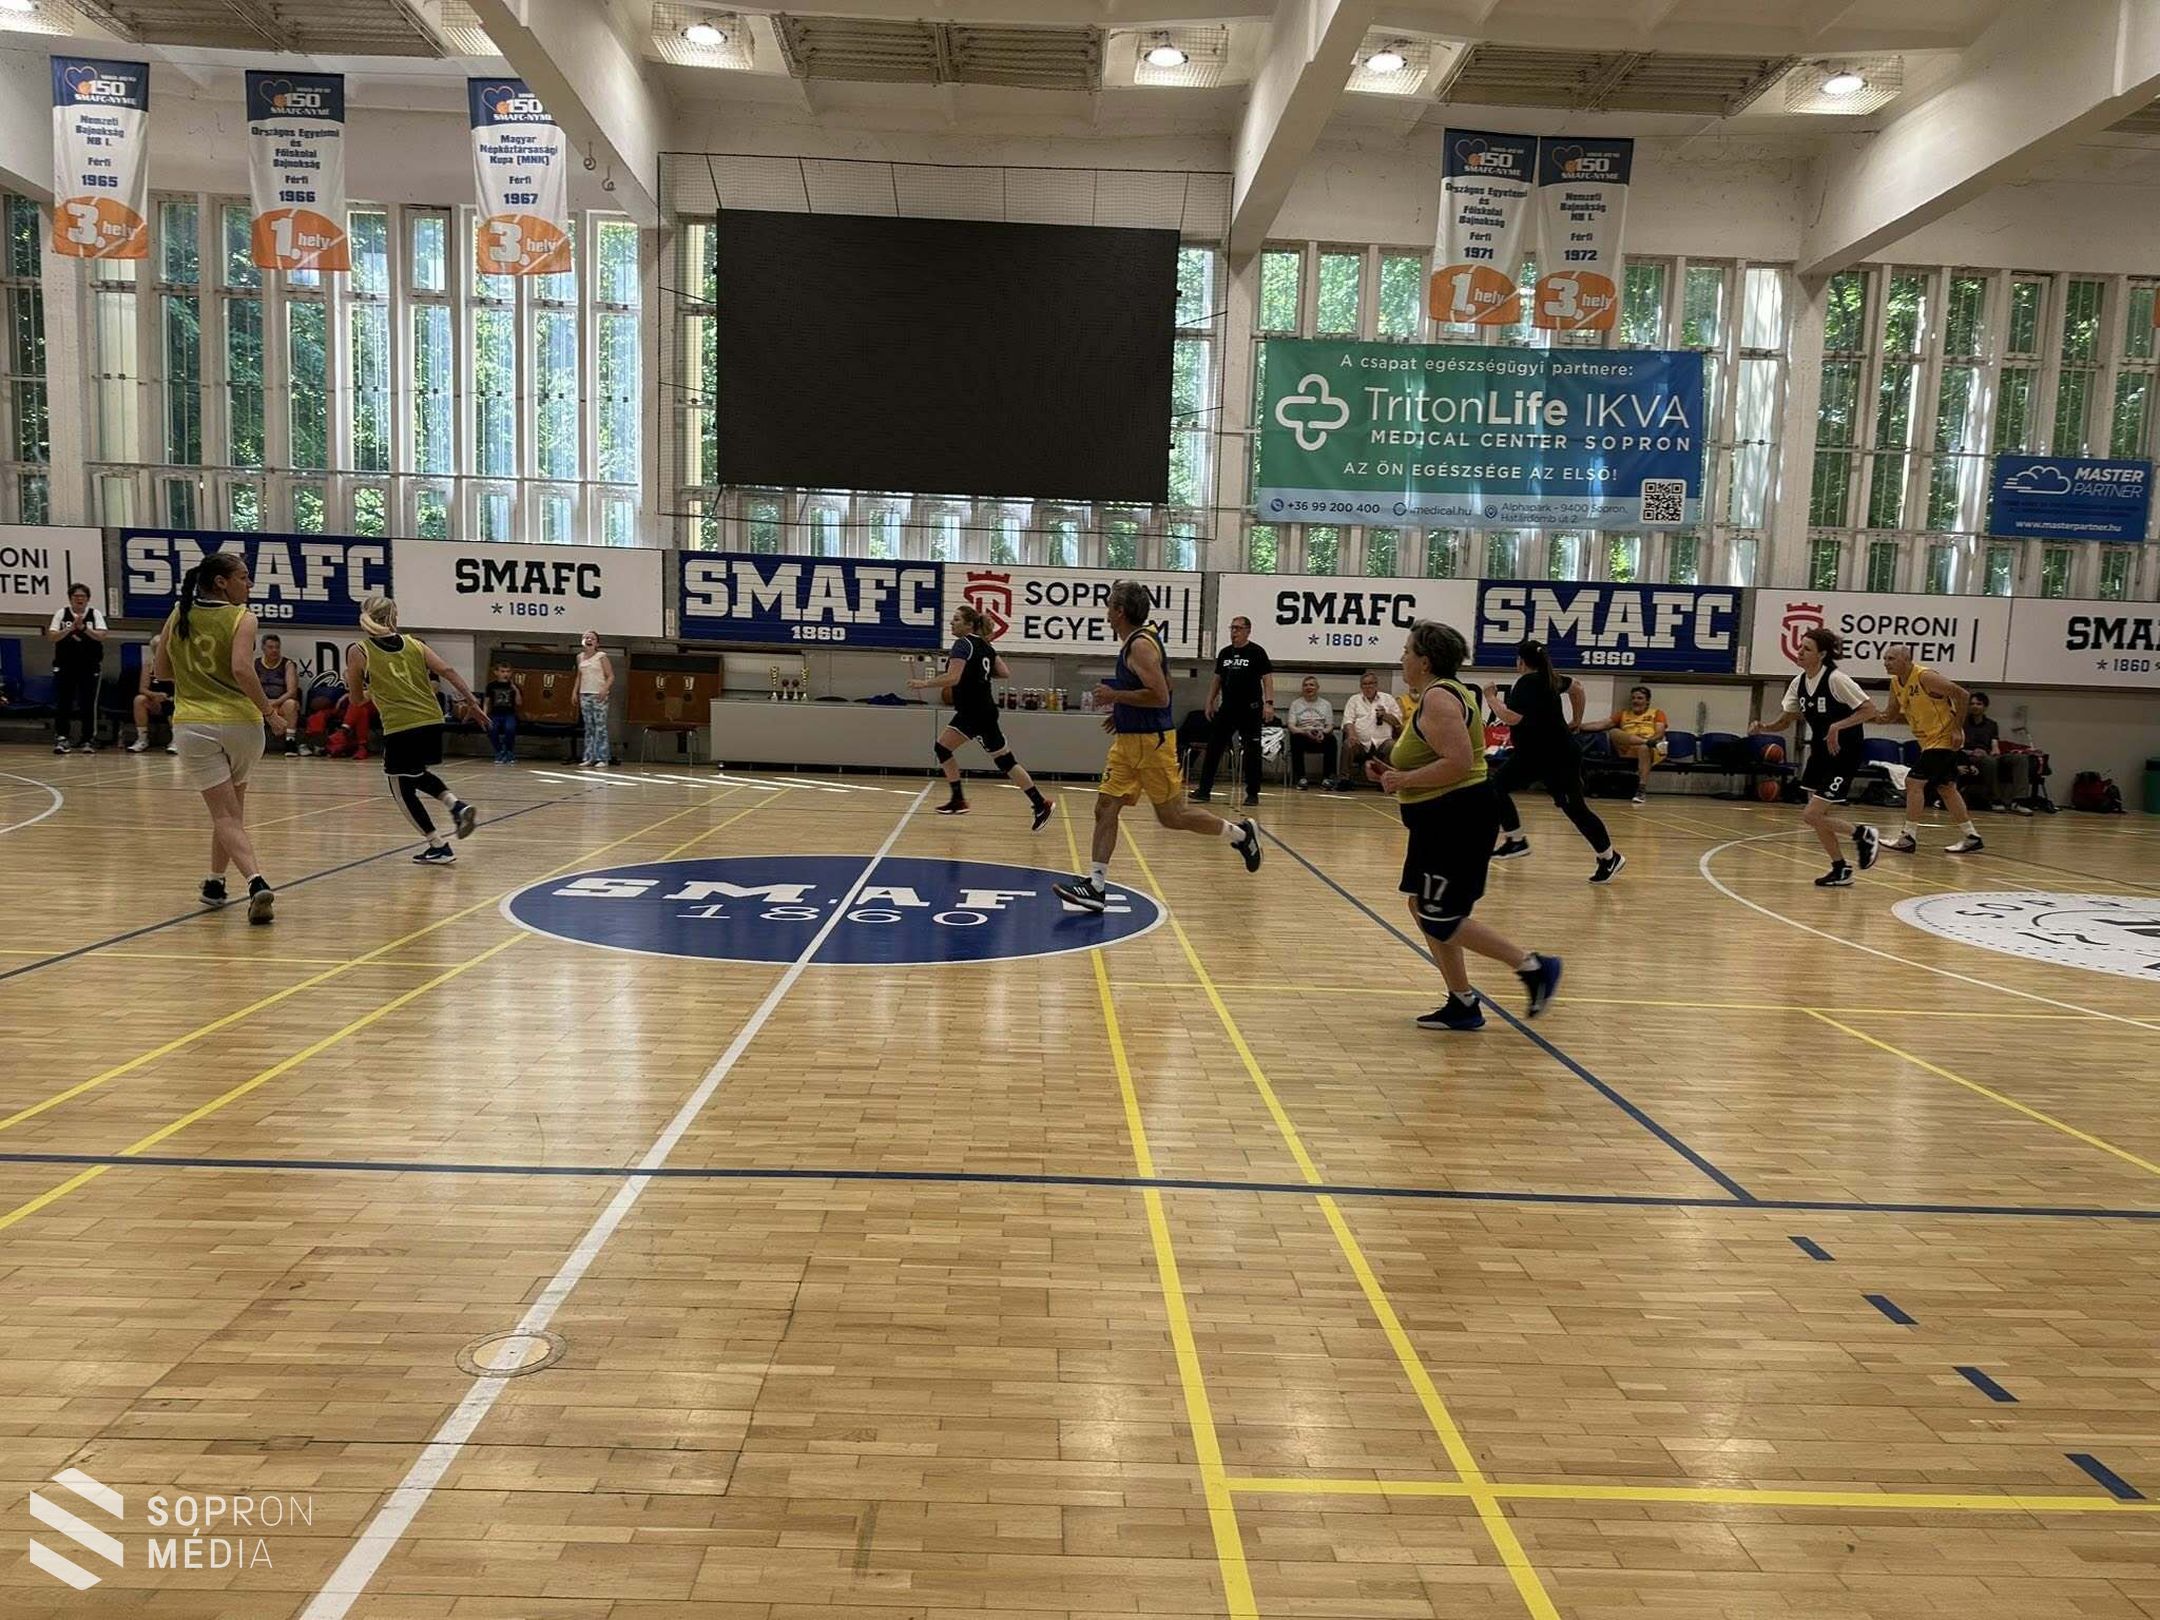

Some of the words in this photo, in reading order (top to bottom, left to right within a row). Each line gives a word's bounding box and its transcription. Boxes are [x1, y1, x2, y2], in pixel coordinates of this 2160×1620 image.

[89, 80, 125, 96] 150
[286, 93, 320, 108] 150
[507, 99, 543, 113] 150
[80, 115, 118, 126] Nemzeti
[75, 125, 124, 138] Bajnokság
[501, 135, 536, 145] Magyar
[88, 157, 111, 167] Férfi
[490, 156, 513, 165] Kupa
[1478, 152, 1513, 168] 150
[1576, 158, 1610, 172] 150
[82, 174, 118, 187] 1965
[285, 175, 309, 184] Férfi
[509, 176, 532, 184] Férfi
[279, 190, 316, 202] 1966
[504, 193, 538, 204] 1967
[67, 202, 106, 248] 3.
[102, 220, 137, 241] hely
[271, 218, 301, 260] 1.
[298, 232, 331, 251] hely
[489, 221, 530, 266] 3.
[526, 236, 556, 255] hely
[1469, 232, 1492, 241] Férfi
[1464, 247, 1494, 259] 1971
[1564, 250, 1597, 261] 1972
[1451, 273, 1476, 316] 1.
[1474, 287, 1505, 306] hely
[1544, 277, 1584, 320] 3.
[1582, 294, 1612, 311] hely
[1340, 354, 1352, 367] A
[1360, 357, 1417, 372] csapat
[1425, 357, 1544, 376] egészségügyi
[1552, 361, 1633, 376] partnere:
[1364, 387, 1568, 427] TritonLife
[1585, 393, 1690, 429] IKVA
[1371, 430, 1470, 446] MEDICAL
[1480, 433, 1567, 449] CENTER
[1585, 436, 1690, 451] SOPRON
[1343, 462, 1368, 475] AZ
[1377, 460, 1403, 475] ÖN
[1412, 461, 1521, 479] EGÉSZSÉGE
[1529, 466, 1555, 480] AZ
[2074, 467, 2145, 483] MASTER
[2072, 483, 2144, 498] PARTNER
[1287, 502, 1308, 511] +36
[1312, 502, 1327, 512] 99
[1329, 502, 1353, 513] 200
[1356, 503, 1380, 513] 400
[1560, 503, 1588, 512] 9400
[2015, 521, 2122, 532] www.masterpartner.hu
[0, 547, 48, 568] ONI
[0, 574, 49, 595] TEM
[456, 558, 601, 599] SMAFC
[684, 559, 936, 626] SMAFC
[1025, 580, 1171, 609] SOPRNI
[249, 603, 294, 618] 860
[509, 602, 549, 617] 1860
[1276, 591, 1416, 628] SMAFC
[1482, 587, 1733, 650] SMAFC
[1841, 614, 1958, 637] SOPRONI
[790, 624, 846, 641] 1860
[1326, 633, 1363, 647] 1860
[185, 634, 217, 674] 13
[1581, 650, 1635, 666] 1860
[982, 657, 990, 681] 9
[2113, 658, 2150, 672] 1860
[1829, 776, 1844, 791] 8
[1423, 872, 1449, 900] 17
[676, 904, 988, 926] 1860
